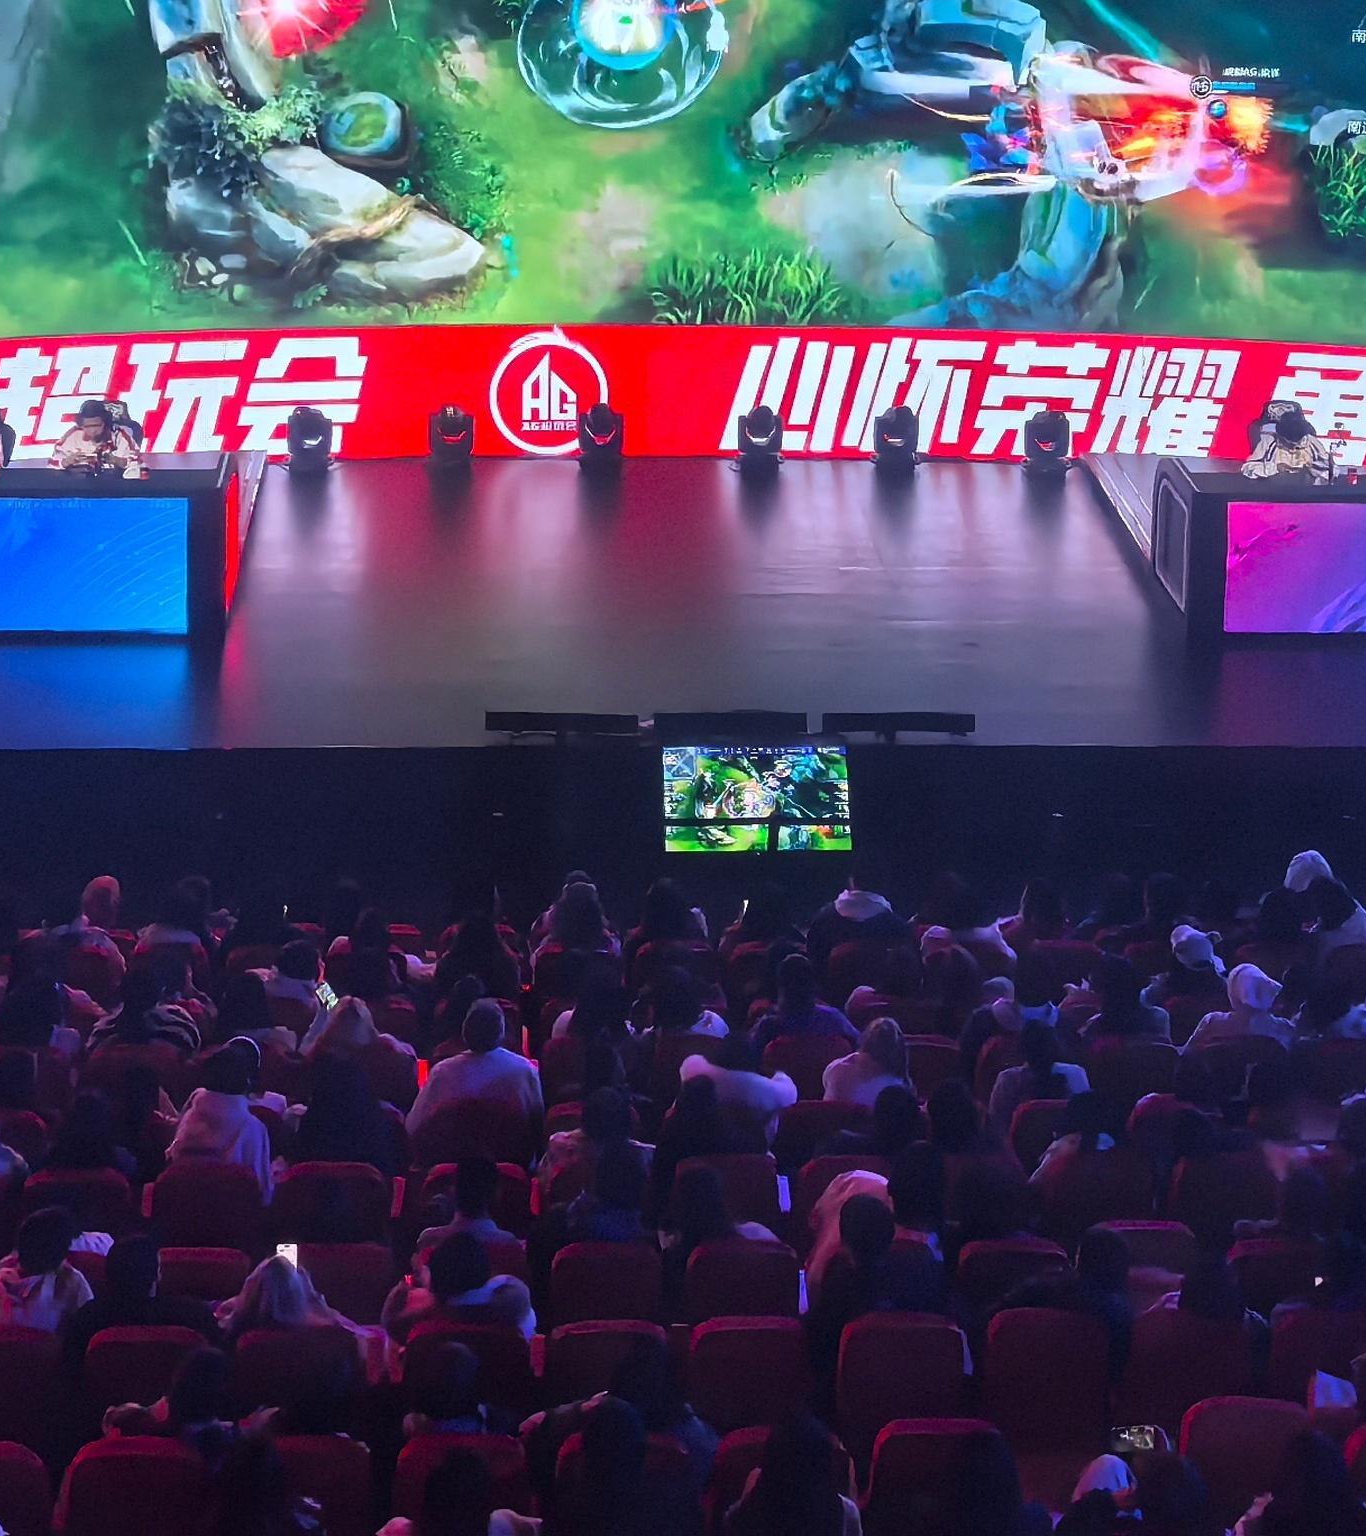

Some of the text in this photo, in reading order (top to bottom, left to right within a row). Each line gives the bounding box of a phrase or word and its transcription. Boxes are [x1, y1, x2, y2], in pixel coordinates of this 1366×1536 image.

[521, 350, 577, 421] AG
[718, 336, 1241, 457] 心怀荣耀
